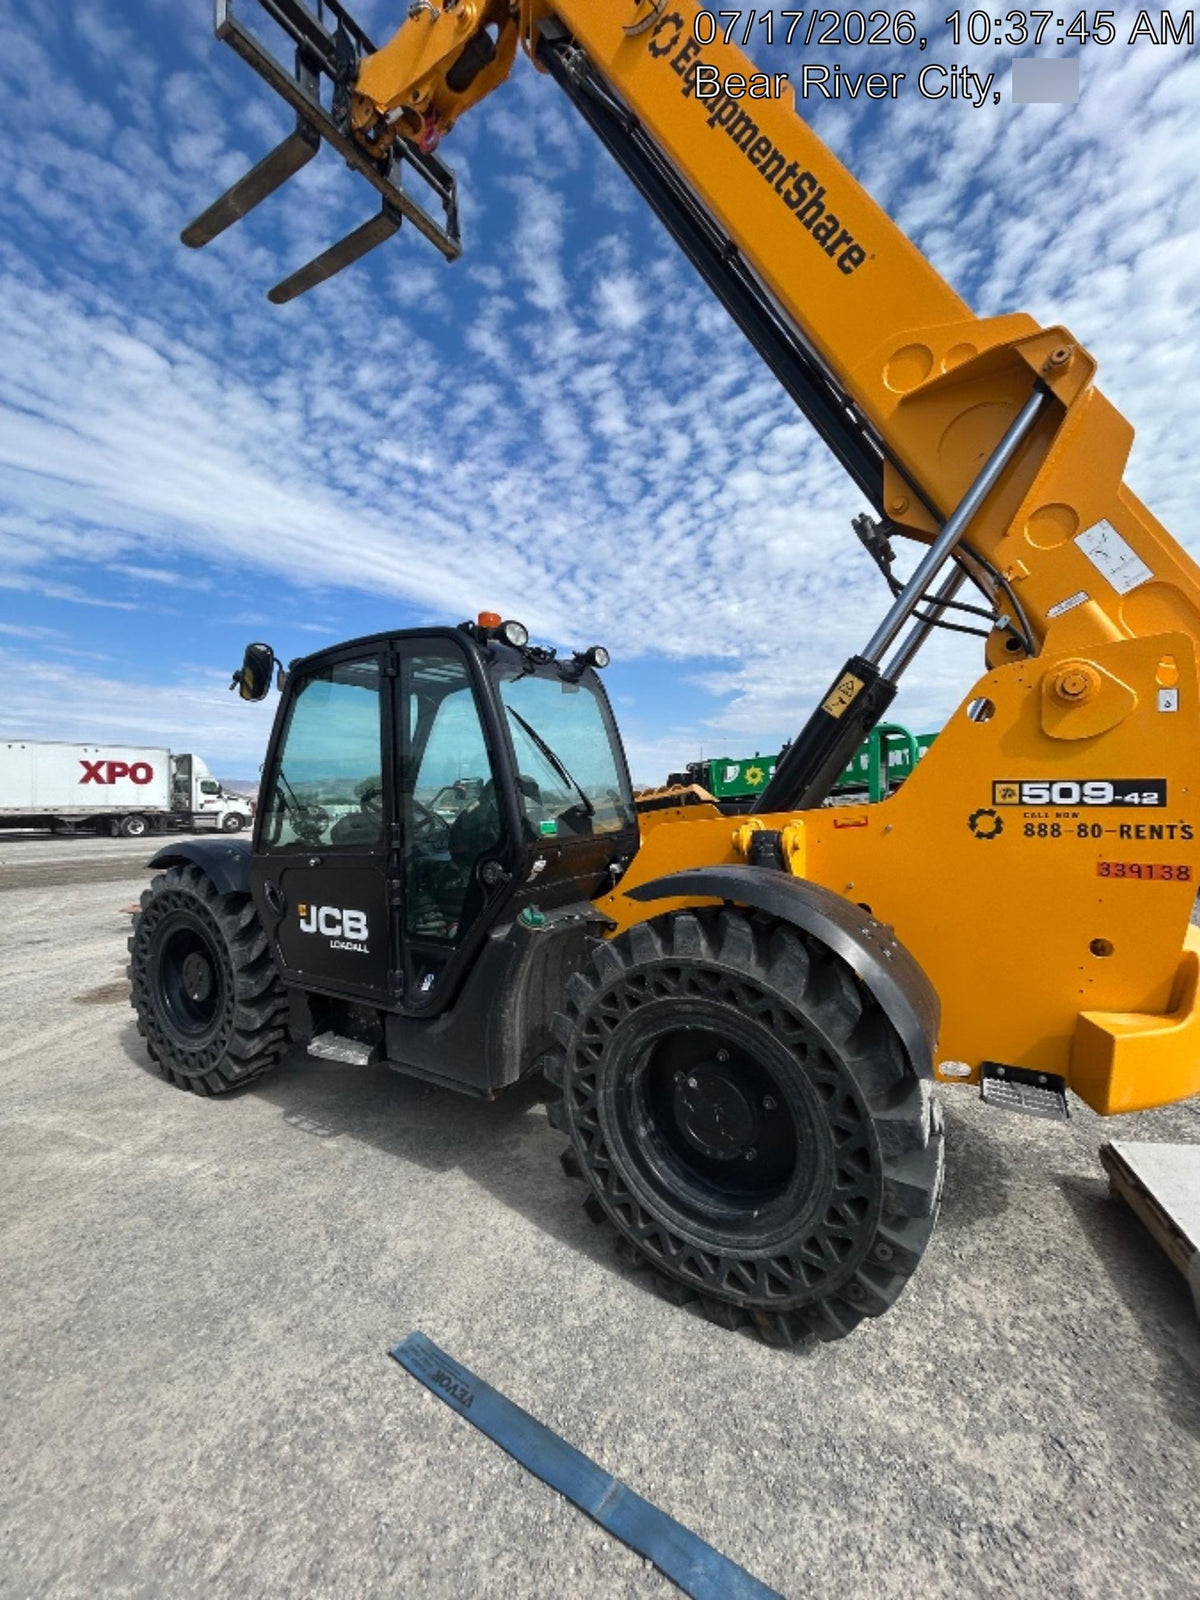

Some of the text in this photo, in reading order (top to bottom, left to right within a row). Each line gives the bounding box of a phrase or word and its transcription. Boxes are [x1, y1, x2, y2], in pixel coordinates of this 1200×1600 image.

[669, 35, 866, 275] EquipmentShare
[79, 761, 153, 784] XPO
[1022, 781, 1159, 804] 509-42
[1024, 822, 1194, 840] 888-80-RENTS
[1099, 862, 1190, 881] 339138
[299, 905, 369, 941] JCB
[431, 1370, 475, 1408] VEVOR
